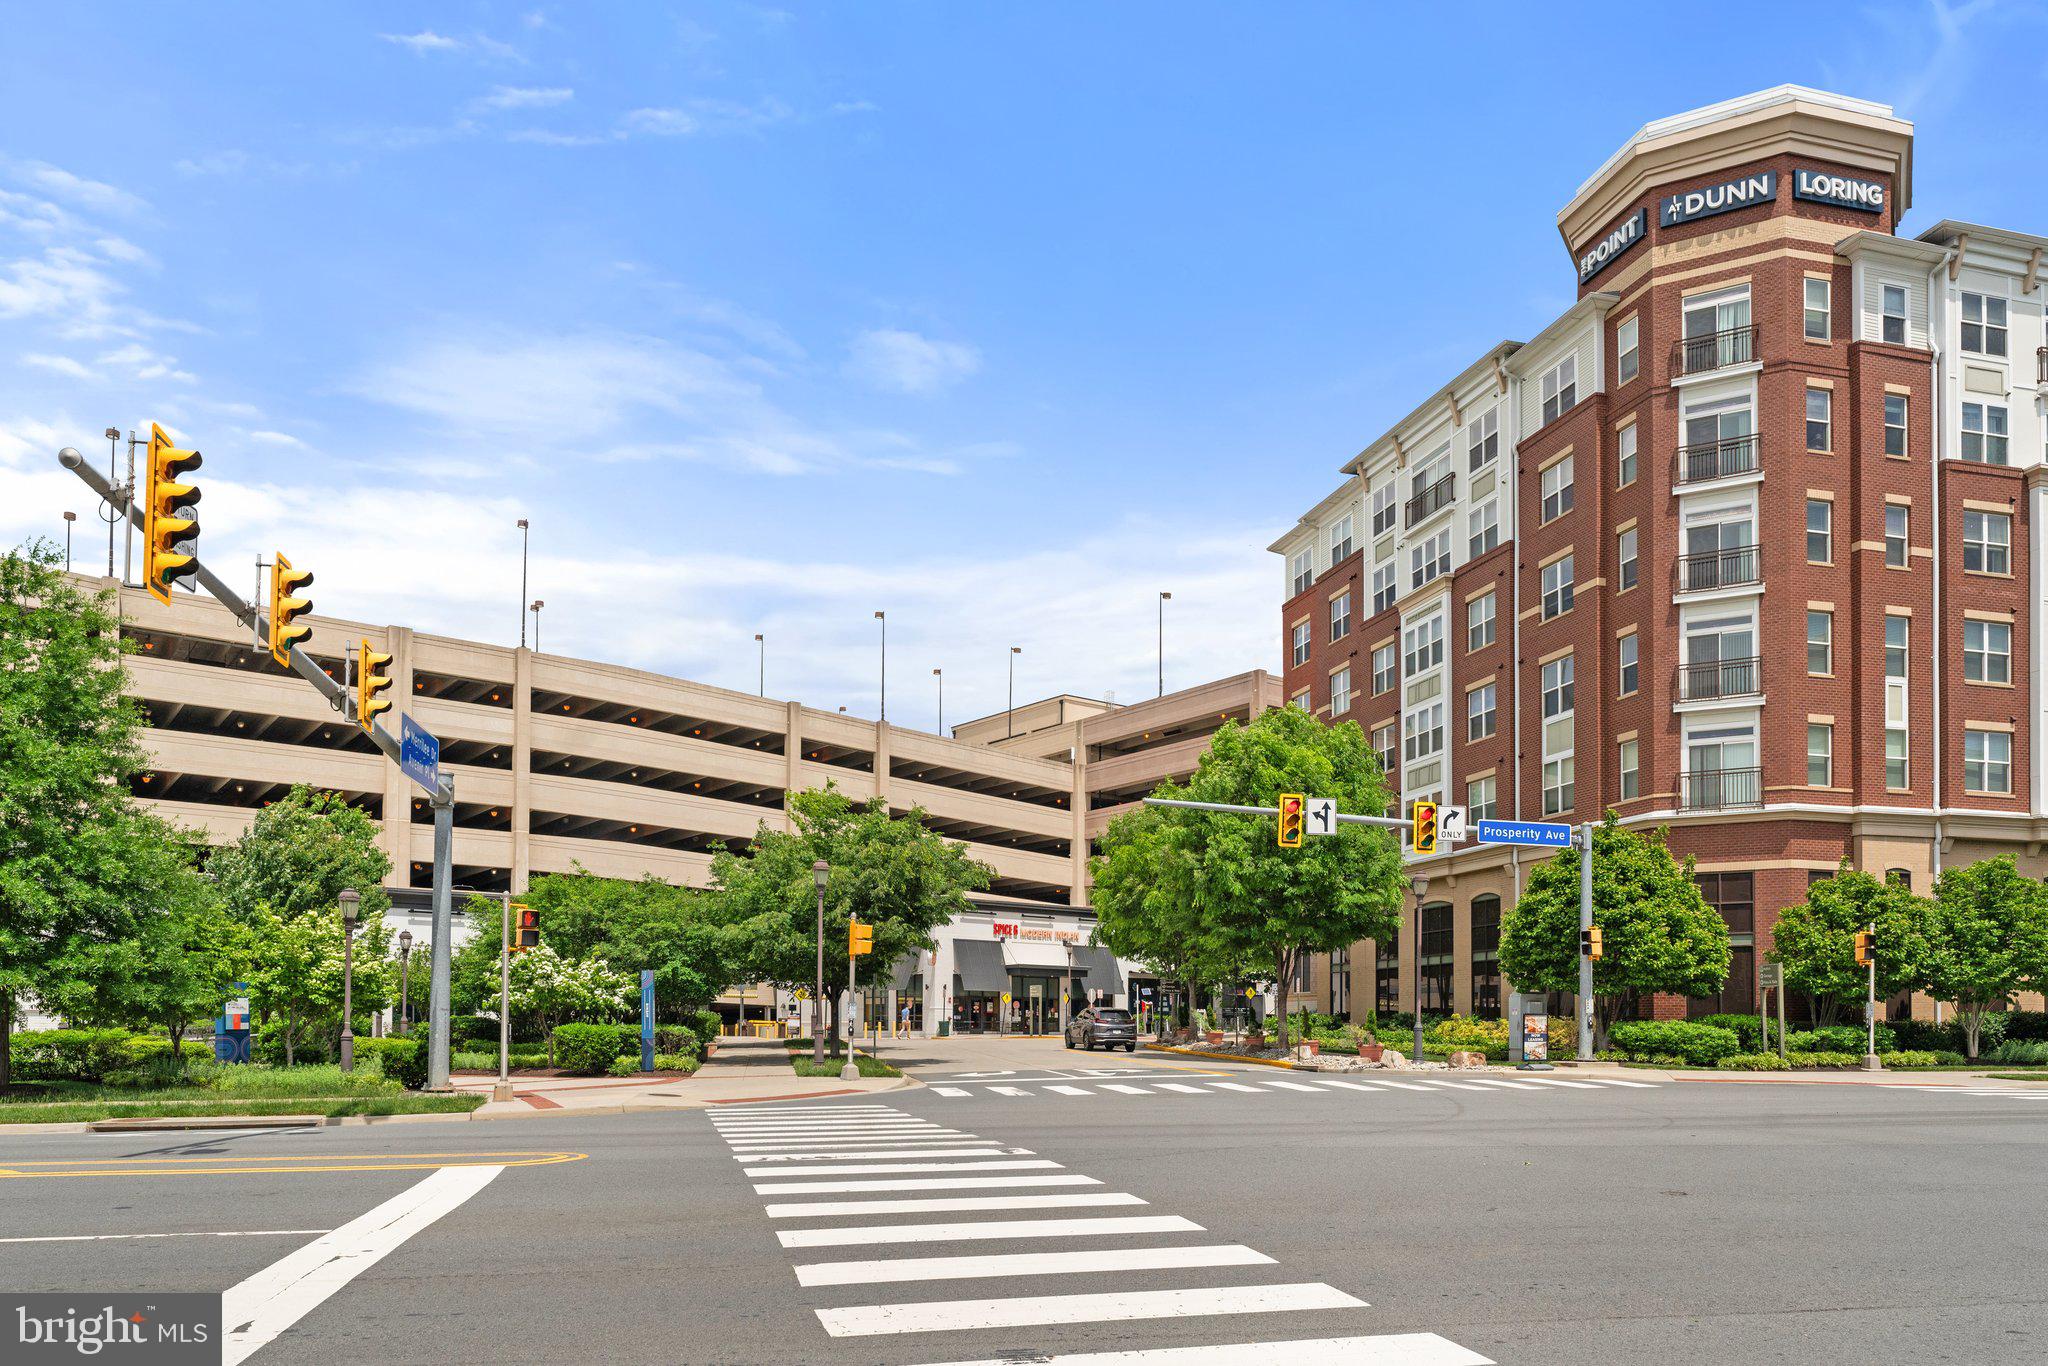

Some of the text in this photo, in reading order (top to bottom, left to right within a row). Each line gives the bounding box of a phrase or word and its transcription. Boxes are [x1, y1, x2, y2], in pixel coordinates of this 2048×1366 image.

[1668, 174, 1769, 216] AT DUNN
[1801, 172, 1883, 206] LORING
[1588, 215, 1639, 272] POINT
[1441, 831, 1462, 839] ONLY
[1484, 826, 1566, 841] Prosperity Ave
[993, 923, 1013, 936] SPICE
[1020, 928, 1053, 939] MODERN
